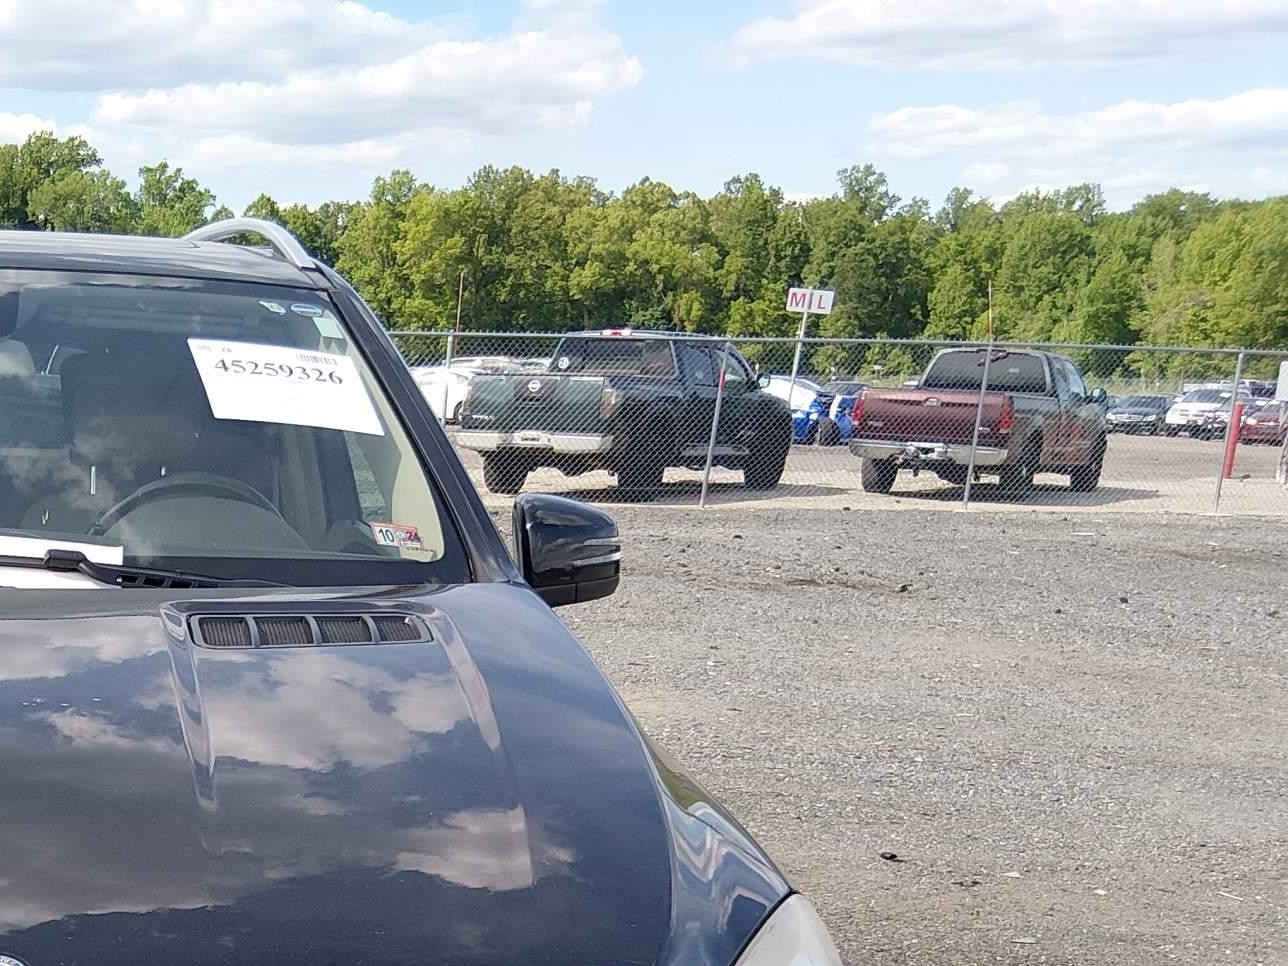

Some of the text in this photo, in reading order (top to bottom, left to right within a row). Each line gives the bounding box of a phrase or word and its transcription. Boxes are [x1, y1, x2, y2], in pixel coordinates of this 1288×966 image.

[789, 292, 826, 310] M L
[214, 358, 344, 385] 45259326
[377, 528, 395, 543] 10
